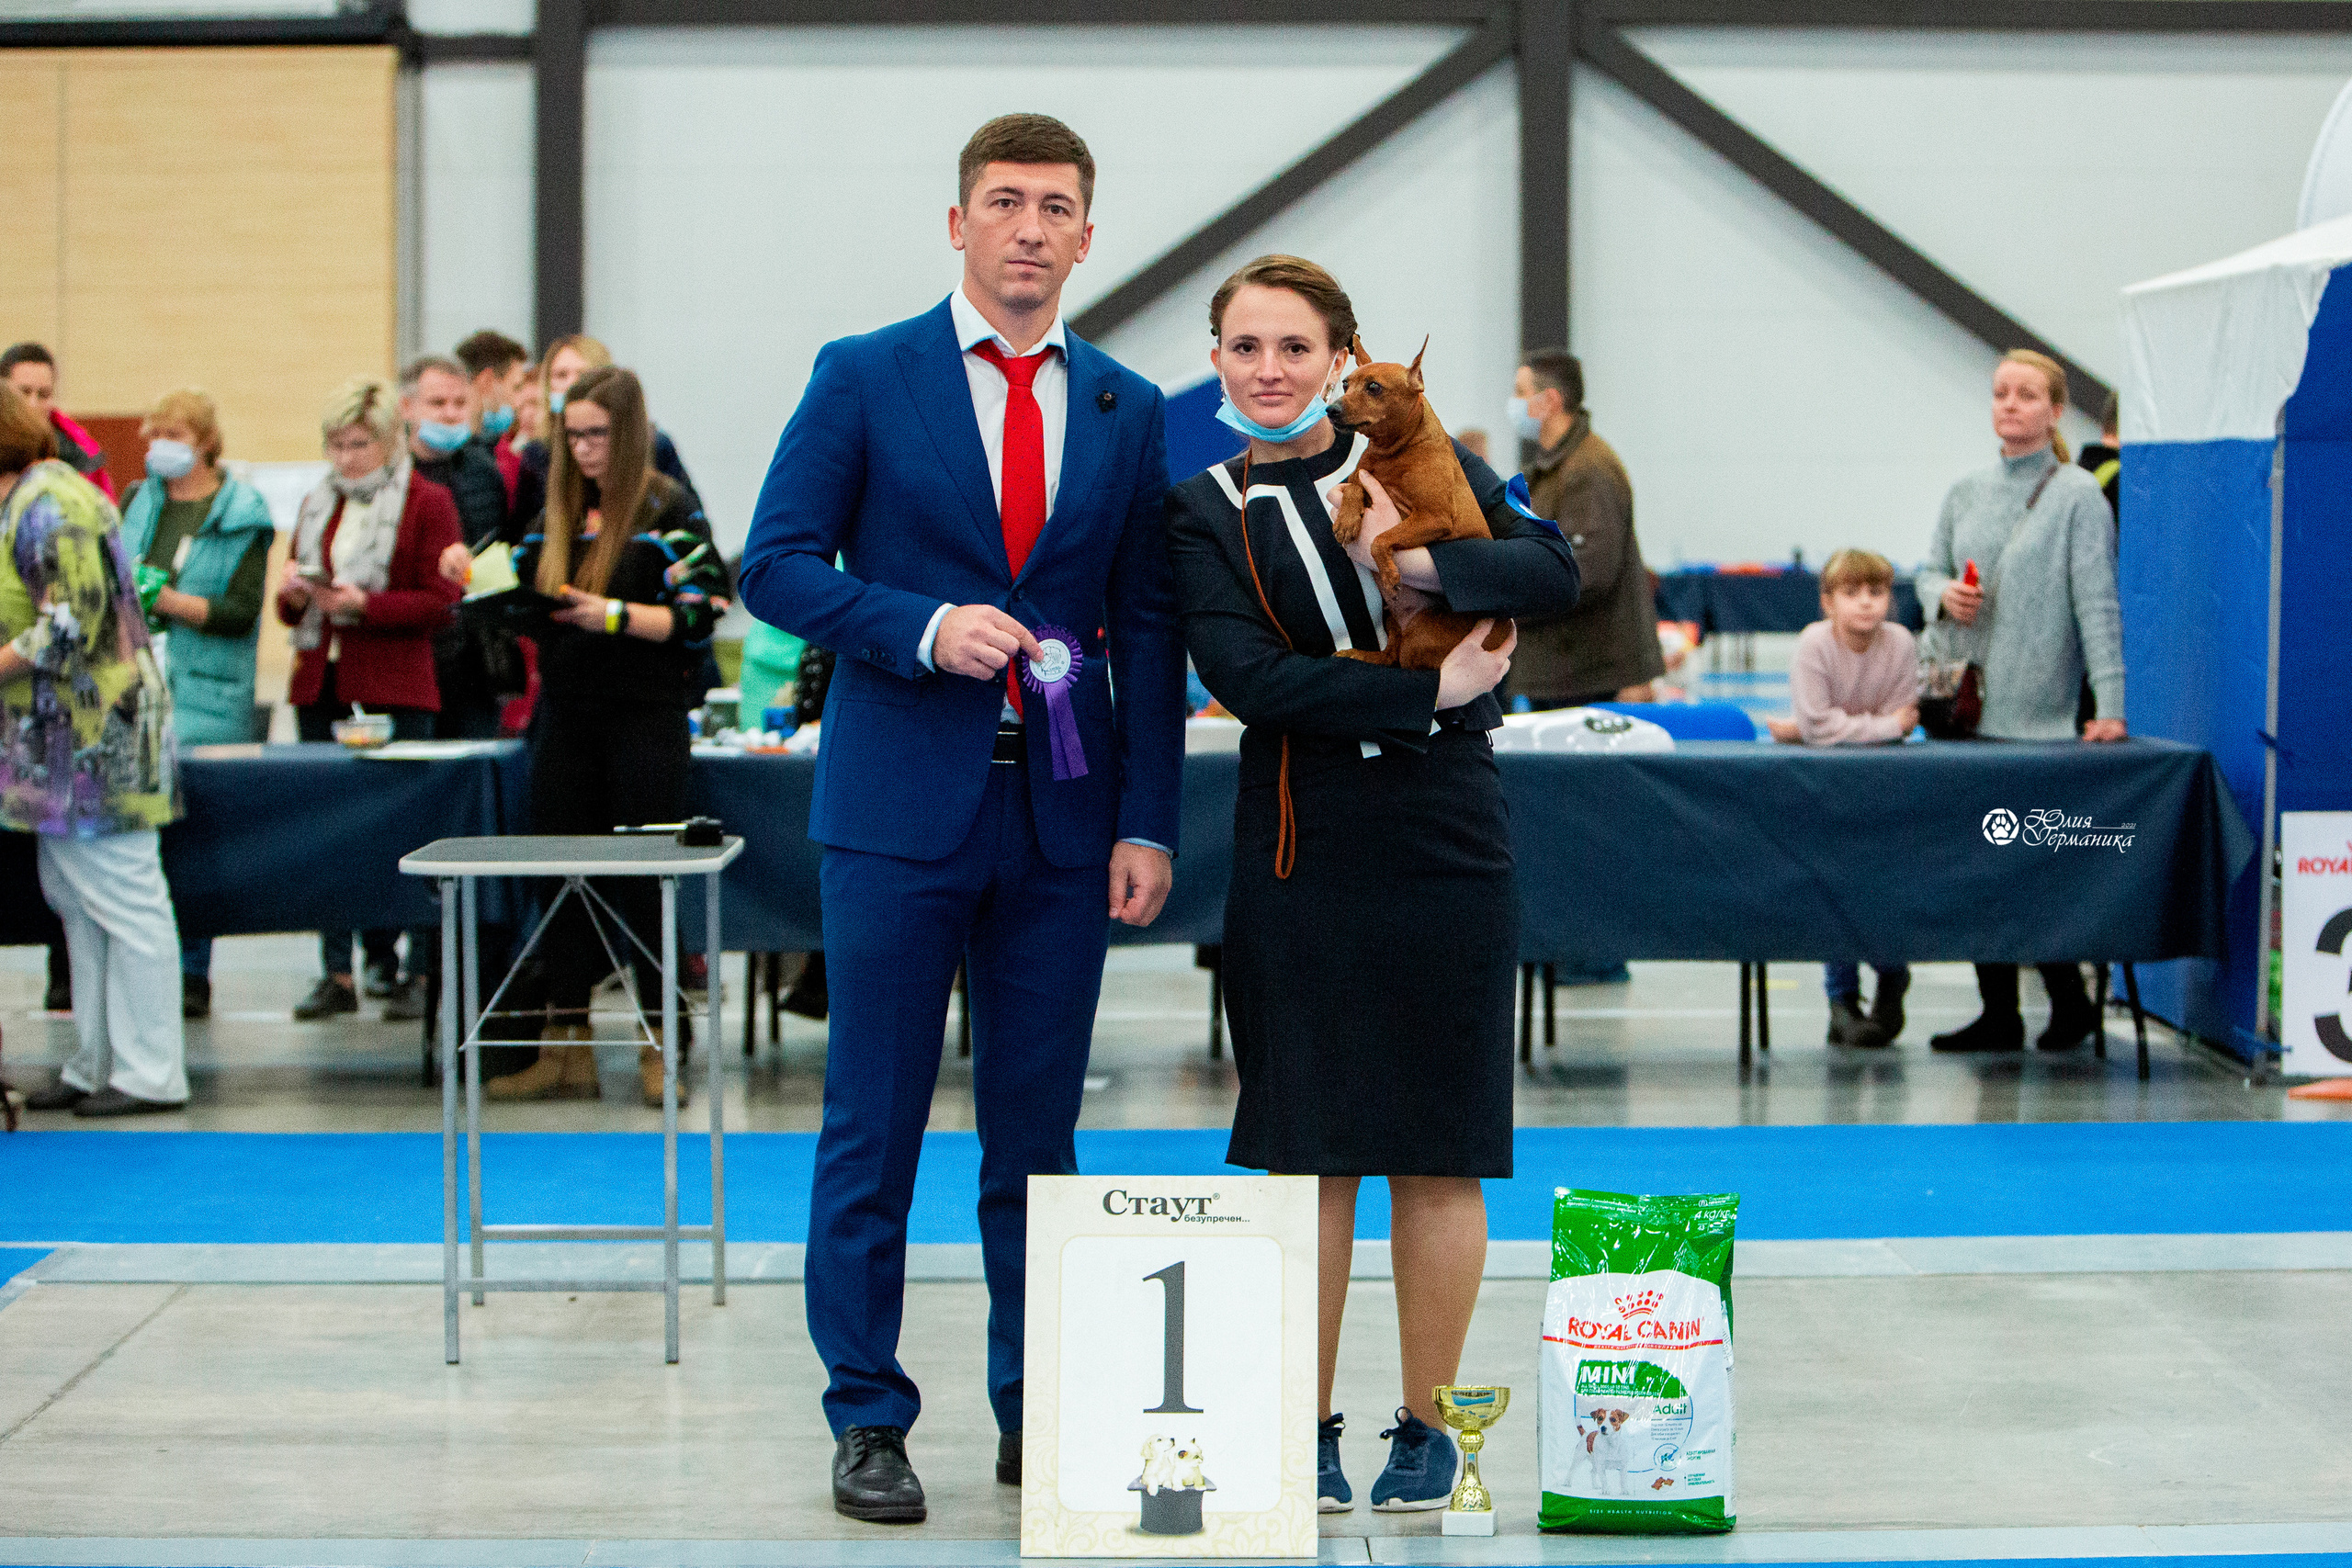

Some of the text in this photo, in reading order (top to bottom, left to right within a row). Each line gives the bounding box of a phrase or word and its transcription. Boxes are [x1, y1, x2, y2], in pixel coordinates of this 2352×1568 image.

[2297, 856, 2352, 874] ROYA
[1183, 1213, 1250, 1224] безупречен...
[1142, 1260, 1204, 1414] 1
[1567, 1316, 1701, 1341] ROYAL CANIN
[1580, 1365, 1636, 1384] MINI
[1653, 1403, 1688, 1415] Adult
